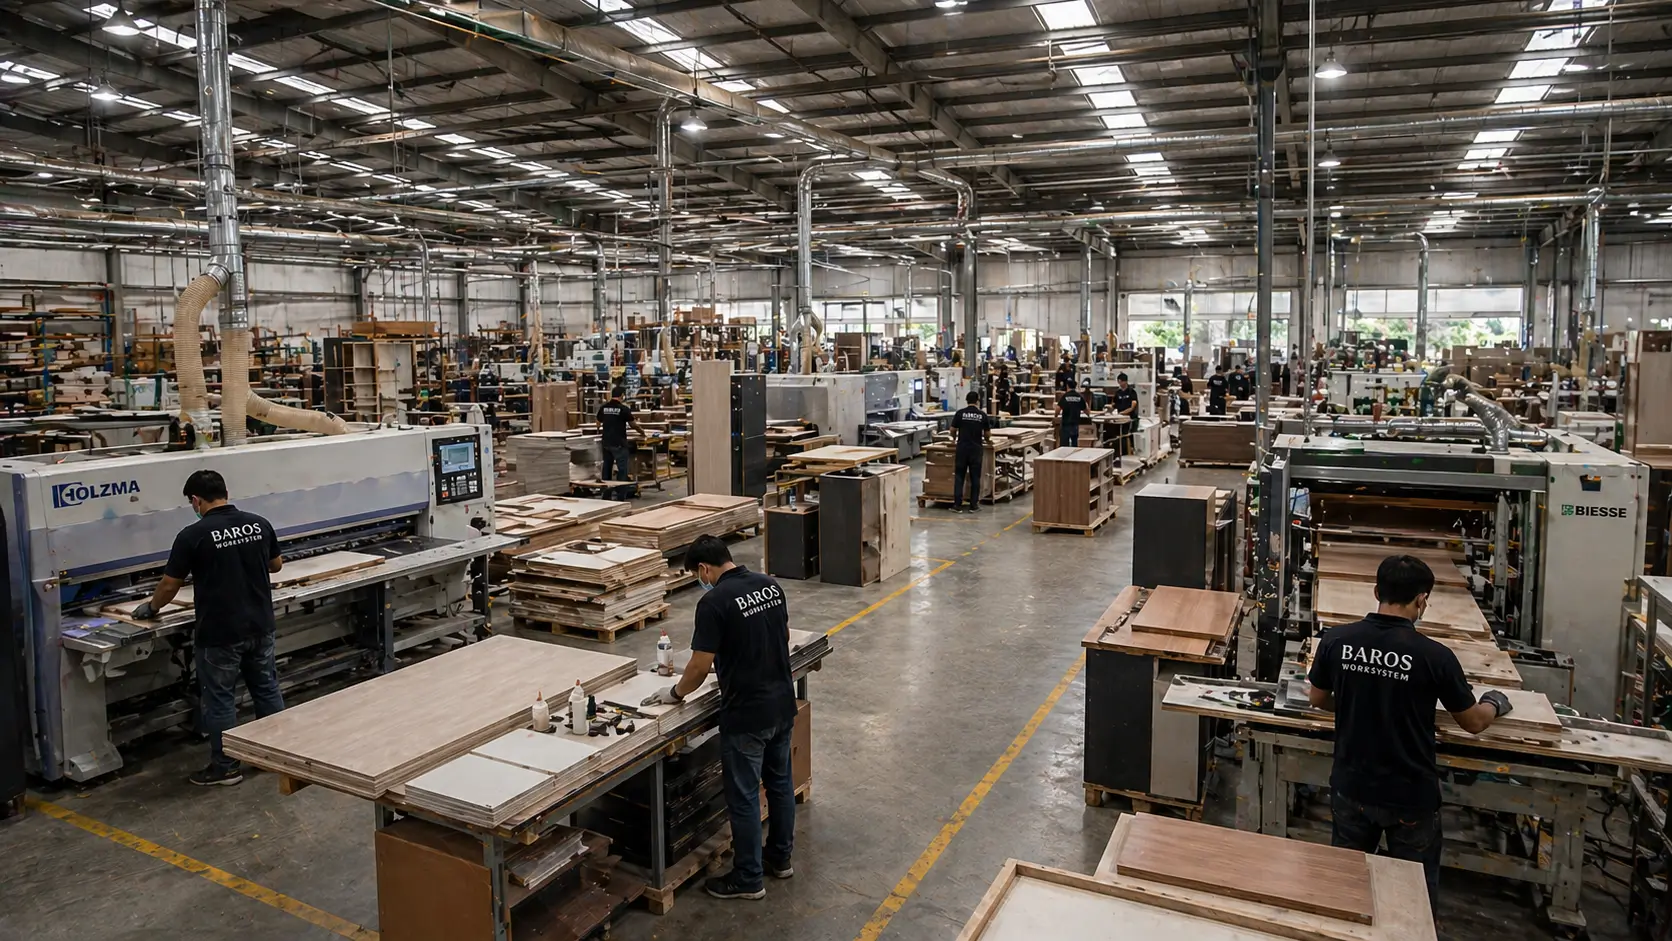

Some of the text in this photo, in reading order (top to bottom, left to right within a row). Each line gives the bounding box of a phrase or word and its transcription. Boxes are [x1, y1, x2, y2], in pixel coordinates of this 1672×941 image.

[1575, 505, 1627, 518] BIESSE
[211, 522, 262, 542] BAROS
[735, 585, 780, 610] BAROS
[1341, 644, 1413, 671] BAROS
[1341, 663, 1409, 682] WORKSYSTEM
